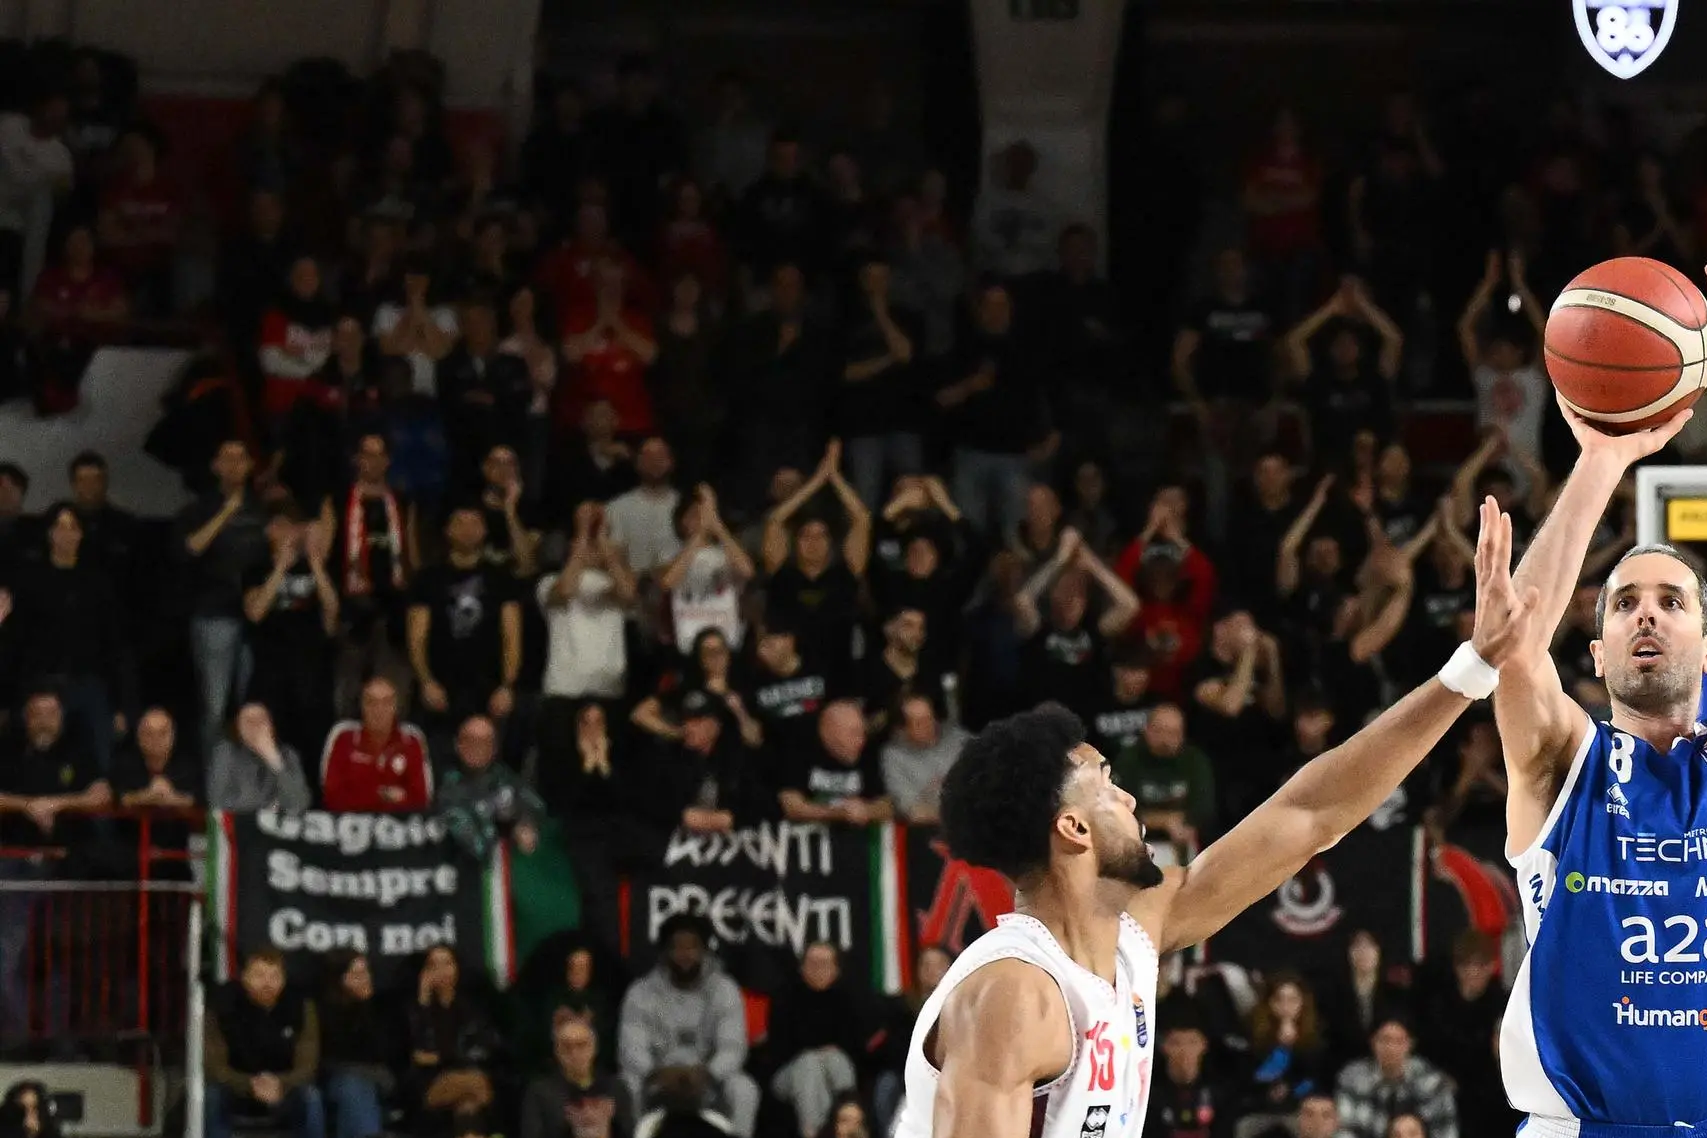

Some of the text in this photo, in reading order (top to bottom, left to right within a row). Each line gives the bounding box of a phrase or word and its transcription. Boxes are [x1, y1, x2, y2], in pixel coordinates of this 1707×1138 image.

[1609, 732, 1635, 783] 8
[267, 849, 459, 907] Sempre
[269, 908, 369, 953] Con
[1620, 970, 1654, 985] LIFE
[1085, 1021, 1115, 1092] 15
